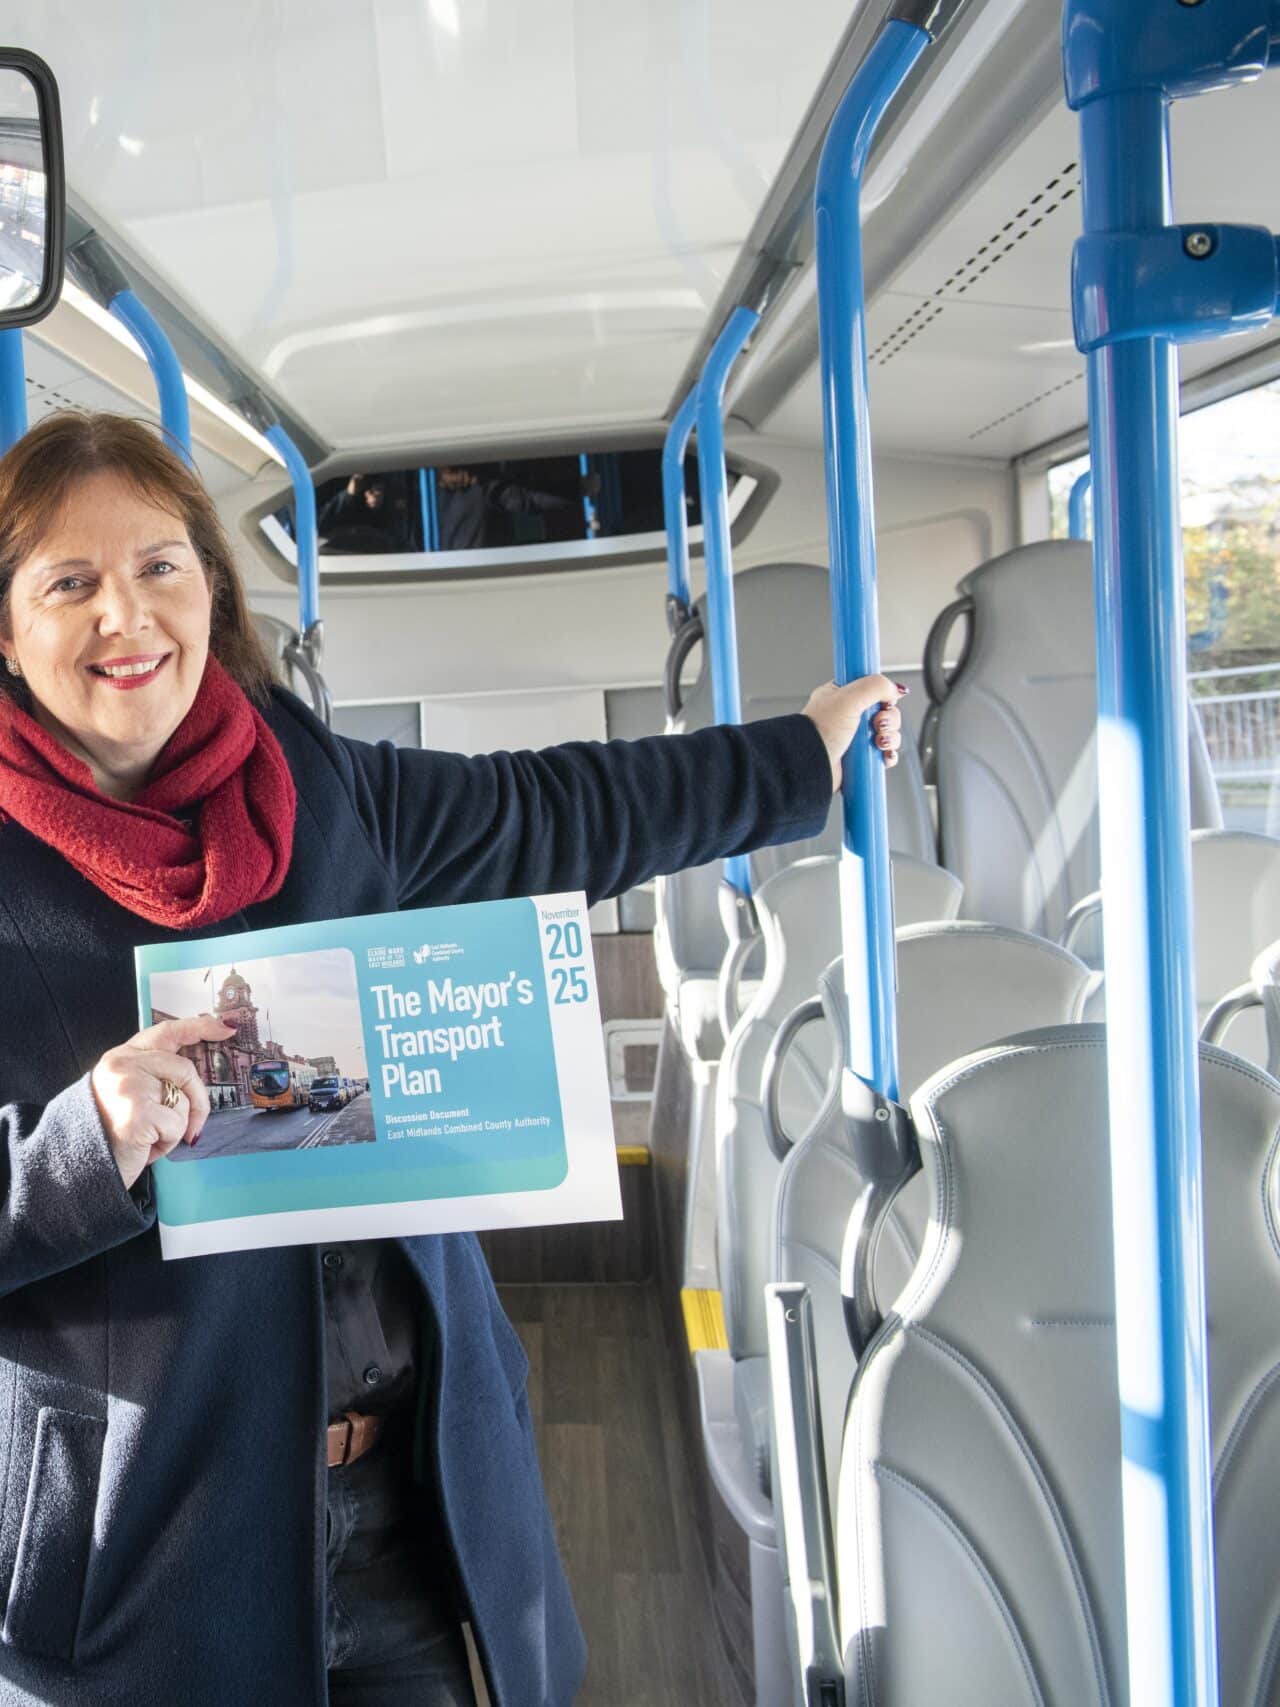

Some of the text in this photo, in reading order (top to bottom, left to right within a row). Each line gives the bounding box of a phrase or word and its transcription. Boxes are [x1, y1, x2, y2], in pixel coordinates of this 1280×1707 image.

[541, 908, 580, 921] November
[545, 921, 583, 960] 20
[370, 971, 534, 1020] The Mayor's
[551, 966, 588, 1005] 25
[374, 1015, 505, 1062] Transport
[381, 1062, 442, 1098] Plan
[385, 1108, 470, 1125] Discussion Document
[387, 1115, 552, 1140] East Midlands Combined County Authority
